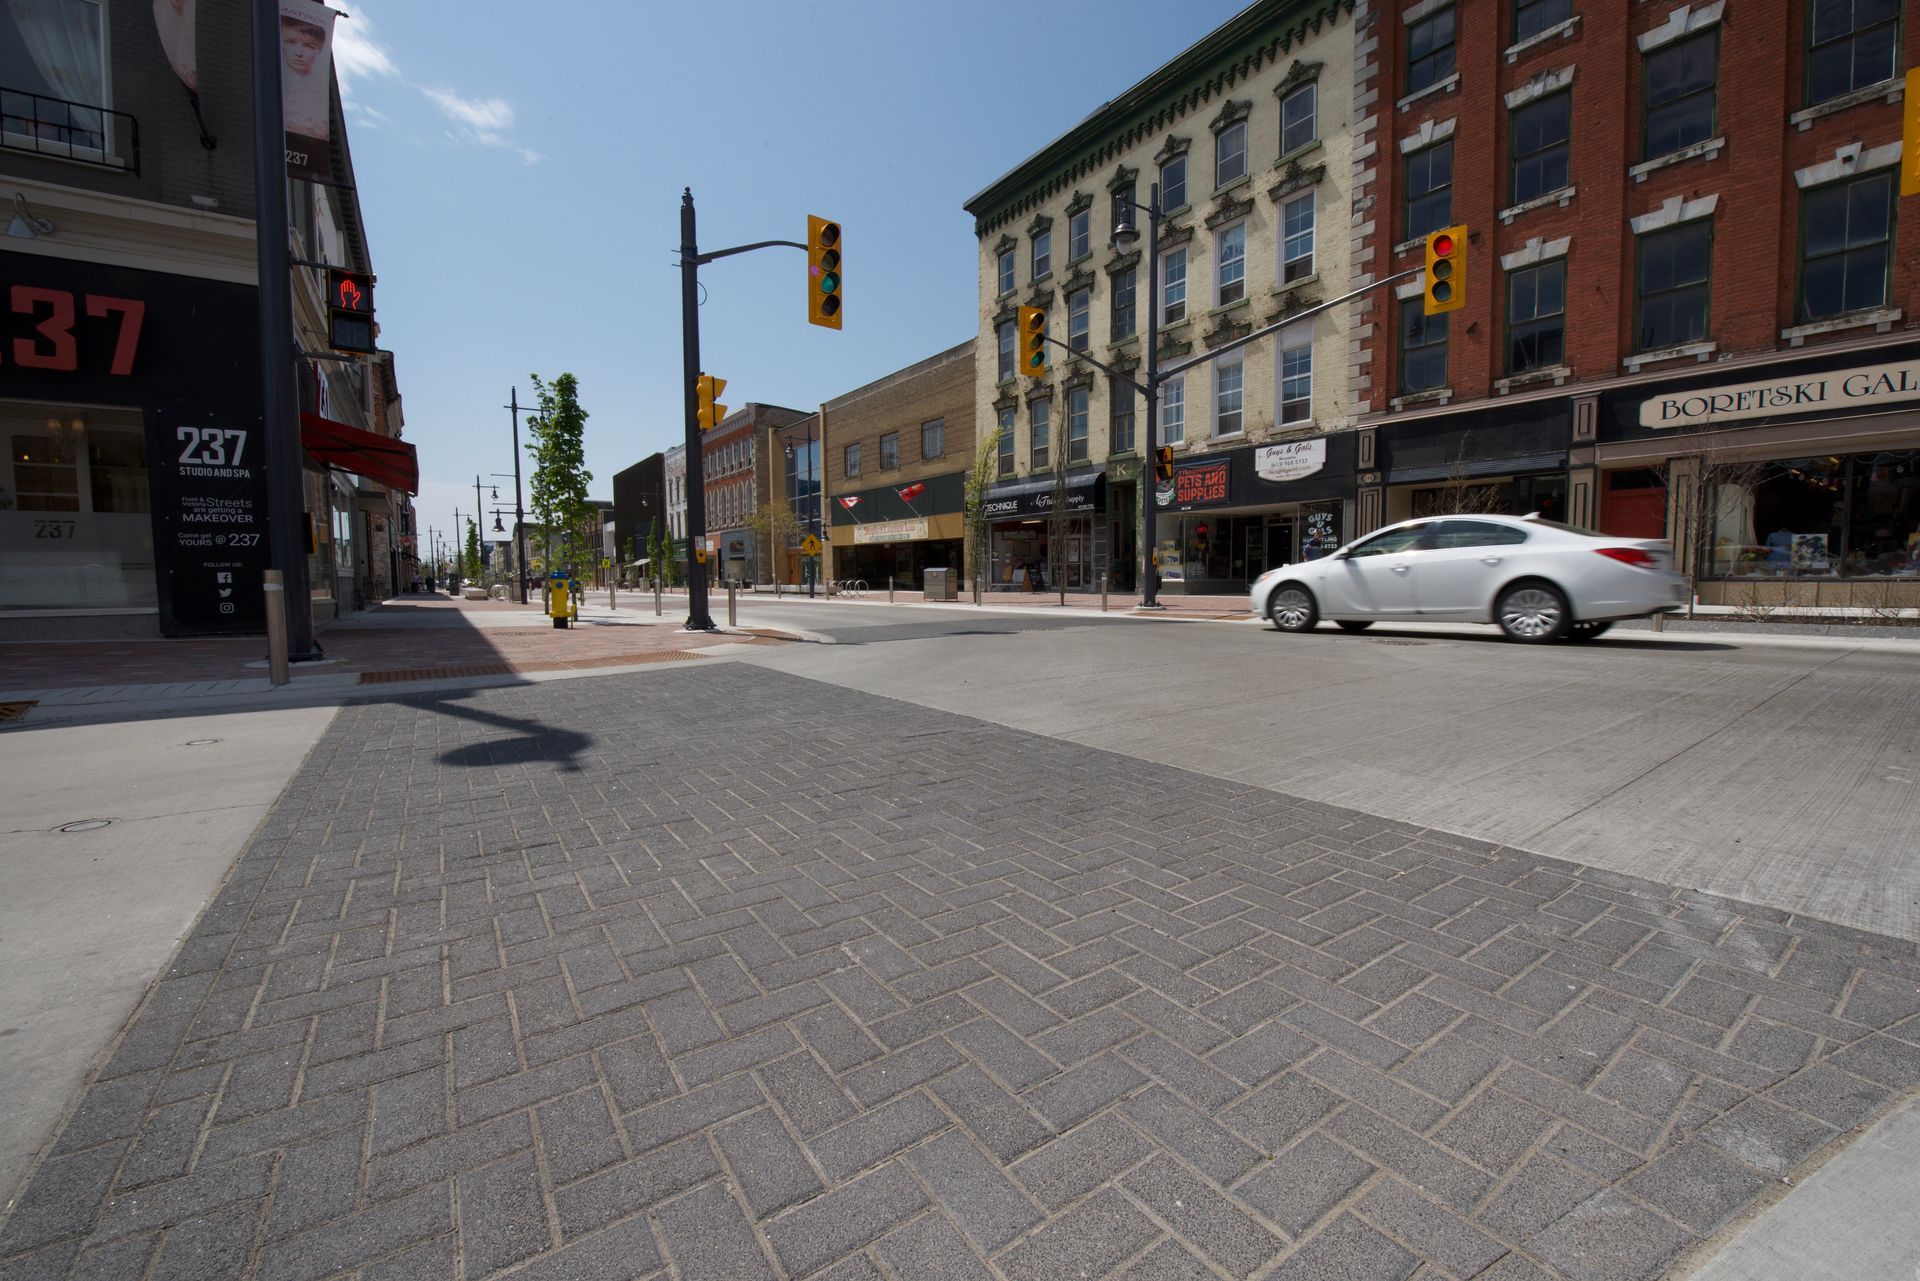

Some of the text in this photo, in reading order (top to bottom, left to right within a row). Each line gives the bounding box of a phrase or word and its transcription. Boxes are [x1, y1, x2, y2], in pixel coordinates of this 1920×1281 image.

[286, 150, 308, 166] 237
[0, 284, 146, 377] 37
[1660, 370, 1920, 420] BORETSKI GAL
[177, 426, 248, 466] 237
[1266, 448, 1283, 459] Guys
[1286, 445, 1292, 453] &
[1294, 442, 1312, 454] Gals
[179, 466, 251, 478] STUDIO AND SPA
[1117, 464, 1127, 476] K
[1178, 474, 1202, 489] PETS
[1204, 471, 1226, 486] AND
[1177, 485, 1225, 502] SUPPLIES
[206, 497, 253, 508] Streets
[182, 513, 254, 523] MAKEOVER
[1308, 512, 1333, 523] GUYS
[34, 520, 76, 538] 237
[1308, 526, 1333, 536] GLS
[215, 533, 260, 546] @ 237
